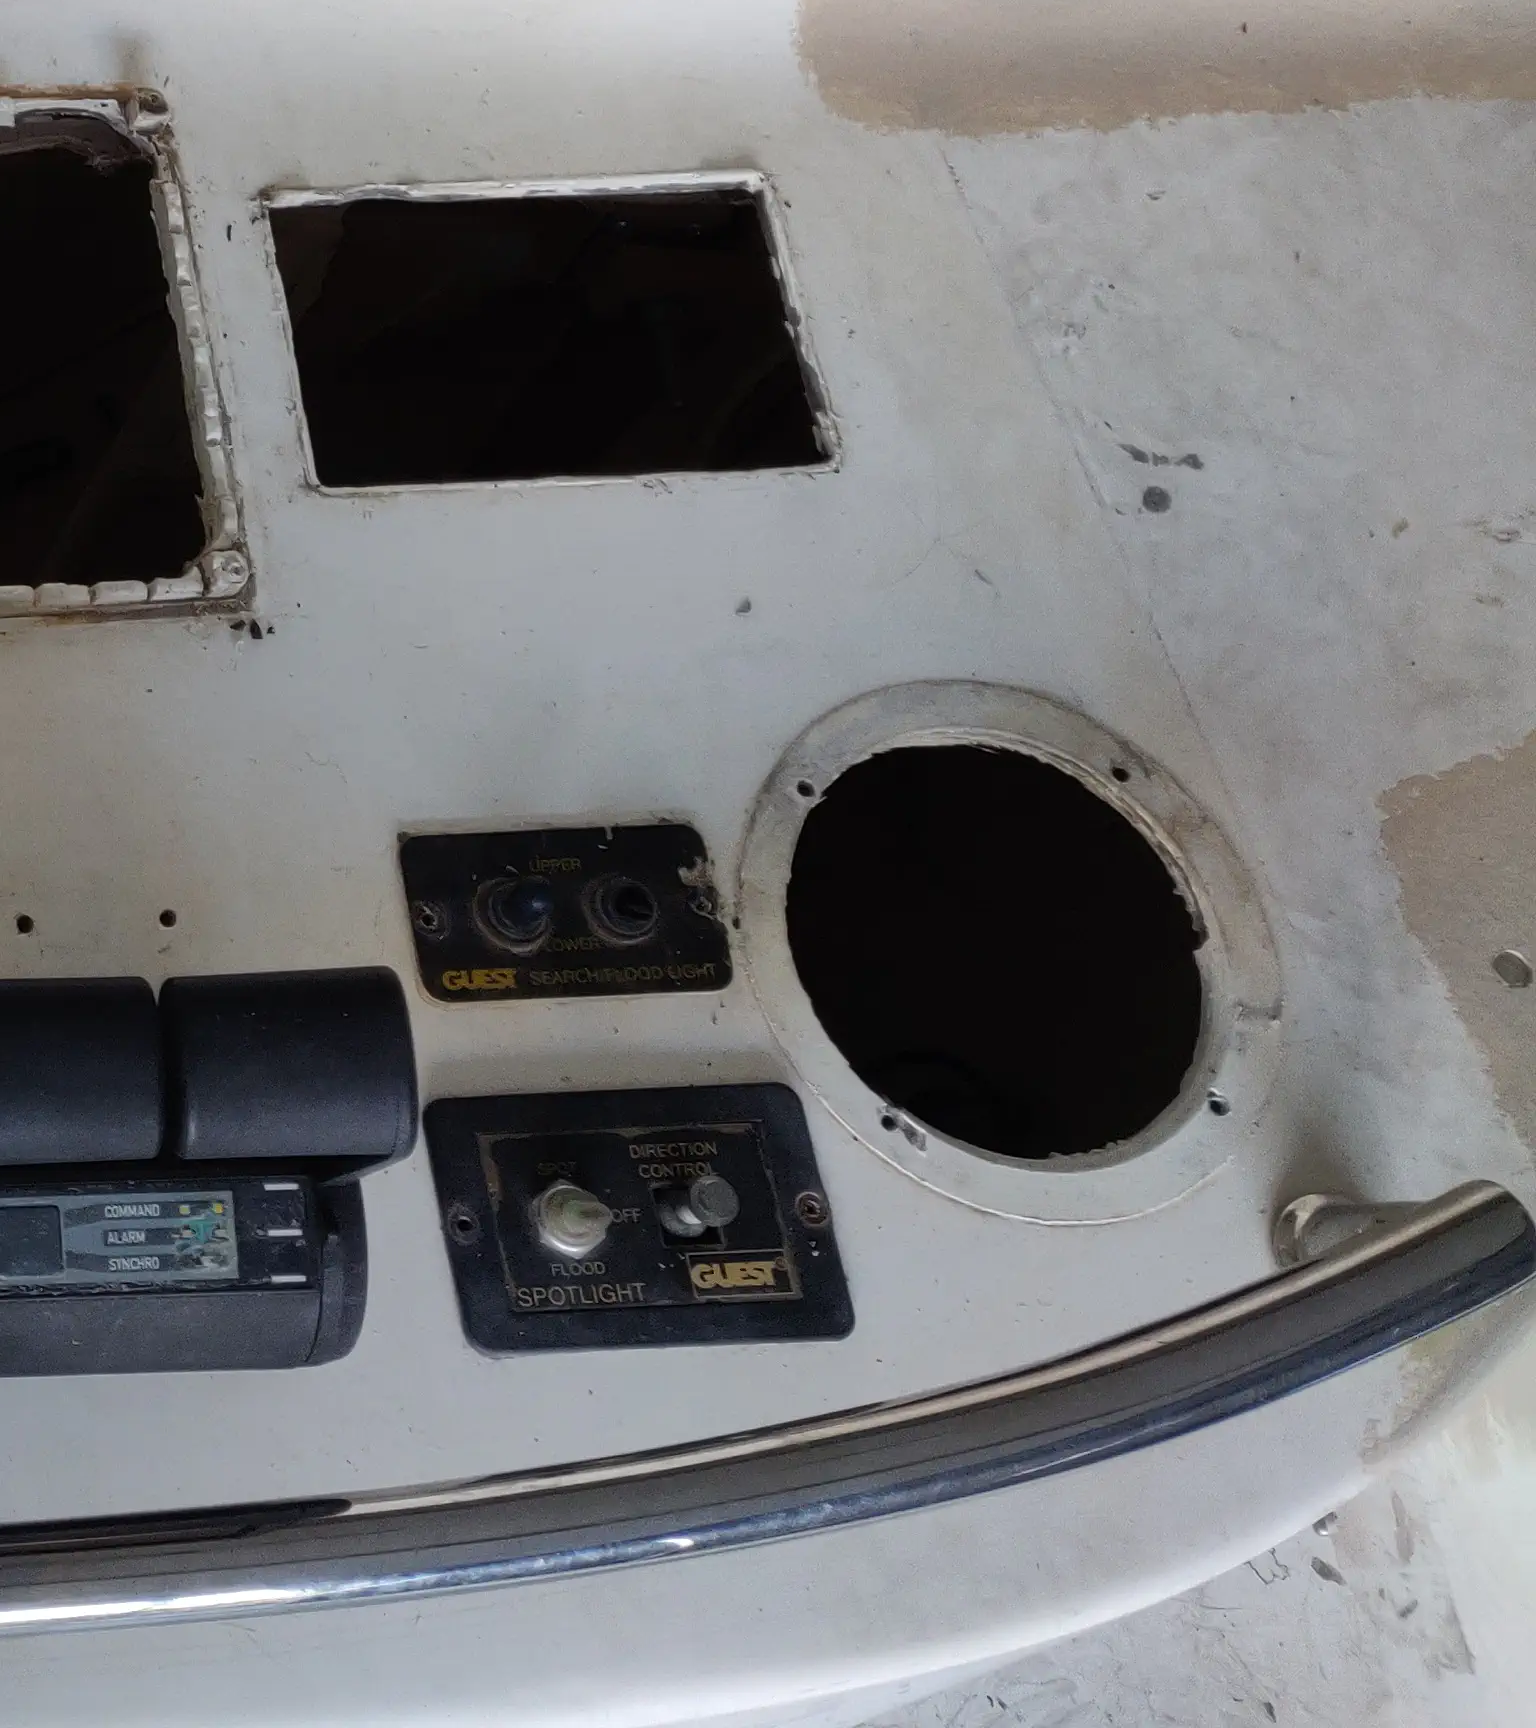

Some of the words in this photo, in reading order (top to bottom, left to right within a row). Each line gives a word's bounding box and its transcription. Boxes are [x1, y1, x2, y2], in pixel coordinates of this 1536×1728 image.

[530, 857, 581, 872] UPPER
[541, 936, 602, 953] LOWER
[442, 968, 517, 991] GUEST
[667, 962, 716, 981] LIGHT
[628, 1142, 718, 1160] DIRECTION
[638, 1162, 714, 1179] CONTROL
[104, 1203, 160, 1218] COMMAND
[611, 1208, 643, 1224] OFF
[107, 1231, 146, 1244] ALARM
[108, 1256, 160, 1271] SYNCHRO
[550, 1261, 606, 1278] FLOOD
[516, 1282, 646, 1308] SPOTLIGHT
